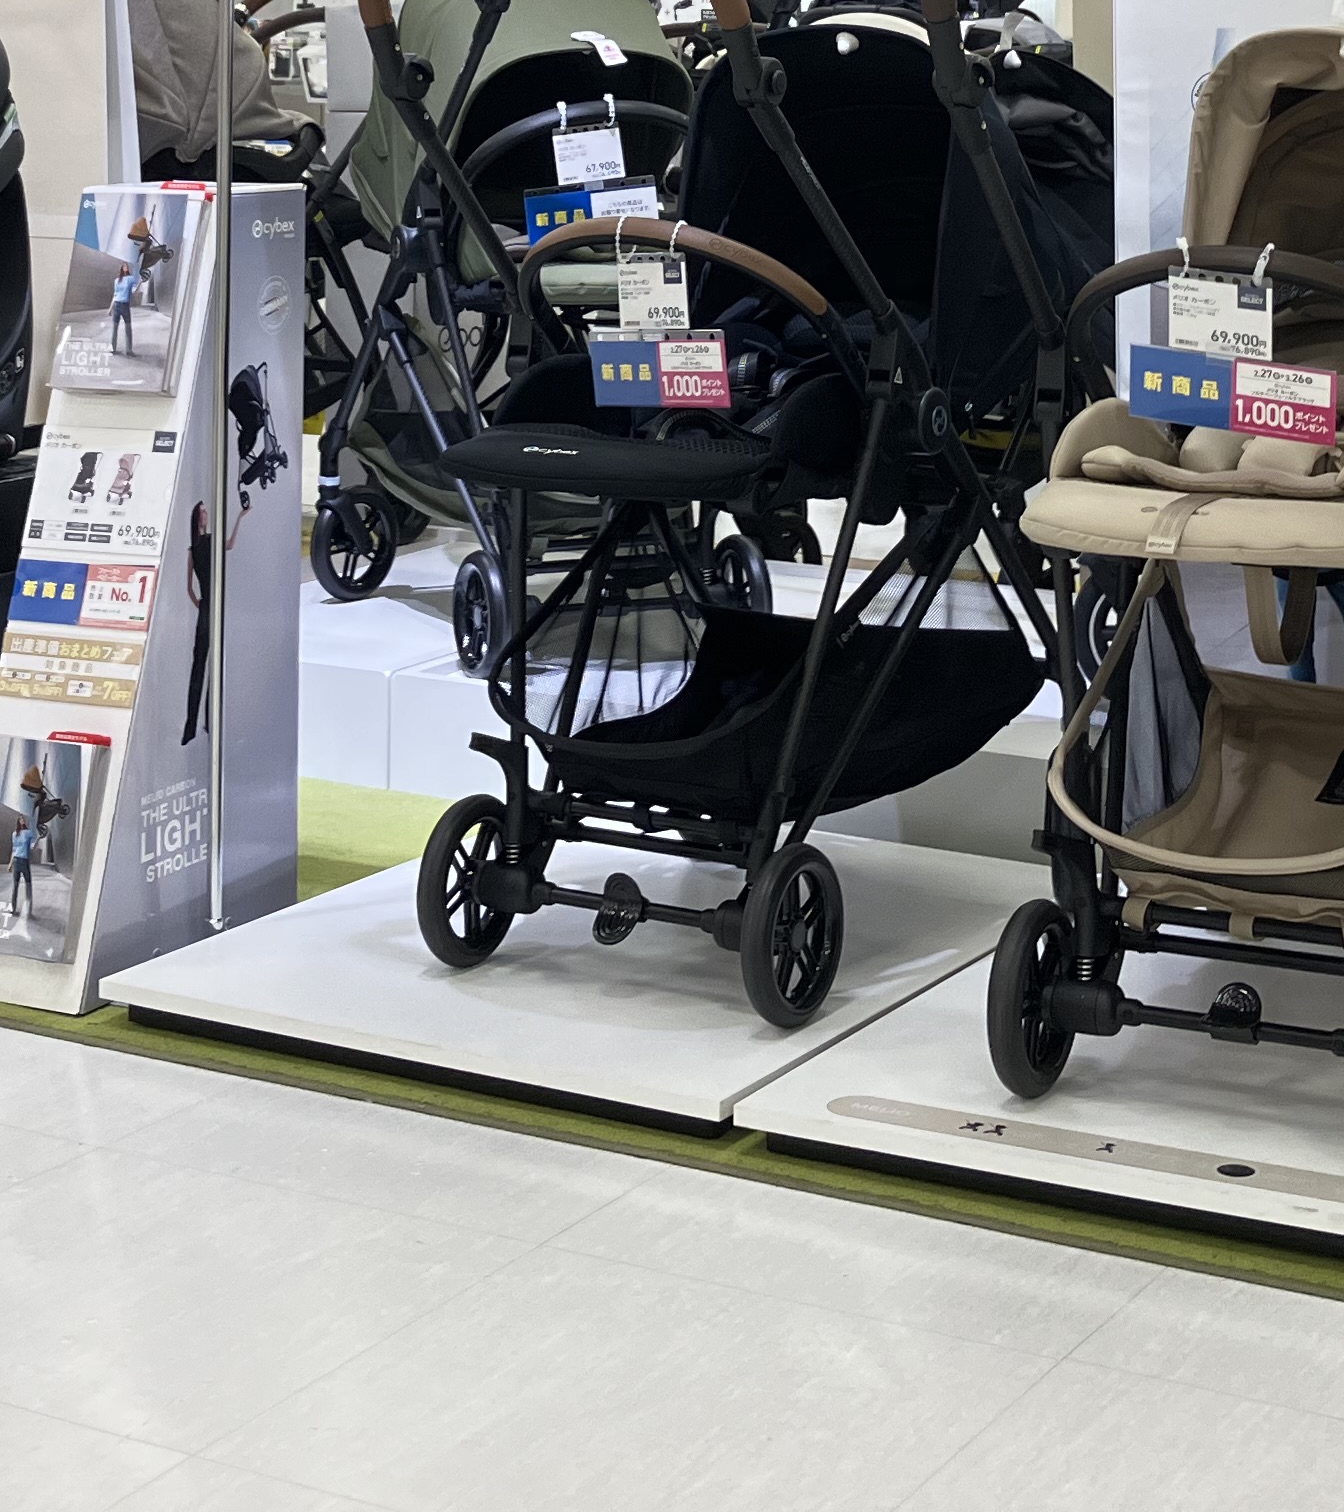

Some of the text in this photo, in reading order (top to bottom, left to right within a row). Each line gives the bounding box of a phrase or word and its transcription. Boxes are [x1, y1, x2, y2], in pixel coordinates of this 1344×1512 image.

[585, 161, 621, 174] 67,900円
[264, 217, 295, 240] cybex
[648, 307, 685, 319] 69,900円
[1211, 329, 1267, 348] 69,900円
[61, 352, 113, 366] LIGHT
[59, 365, 111, 377] STROLLER
[662, 375, 701, 398] 1,000
[1144, 371, 1219, 400] 新商品
[1235, 398, 1326, 429] 1,000 ポイント
[1295, 421, 1329, 435] プレゼント
[22, 580, 76, 600] 新商品
[141, 788, 209, 827] THE ULTR
[140, 808, 209, 864] LIGH
[146, 844, 208, 883] STROLLE
